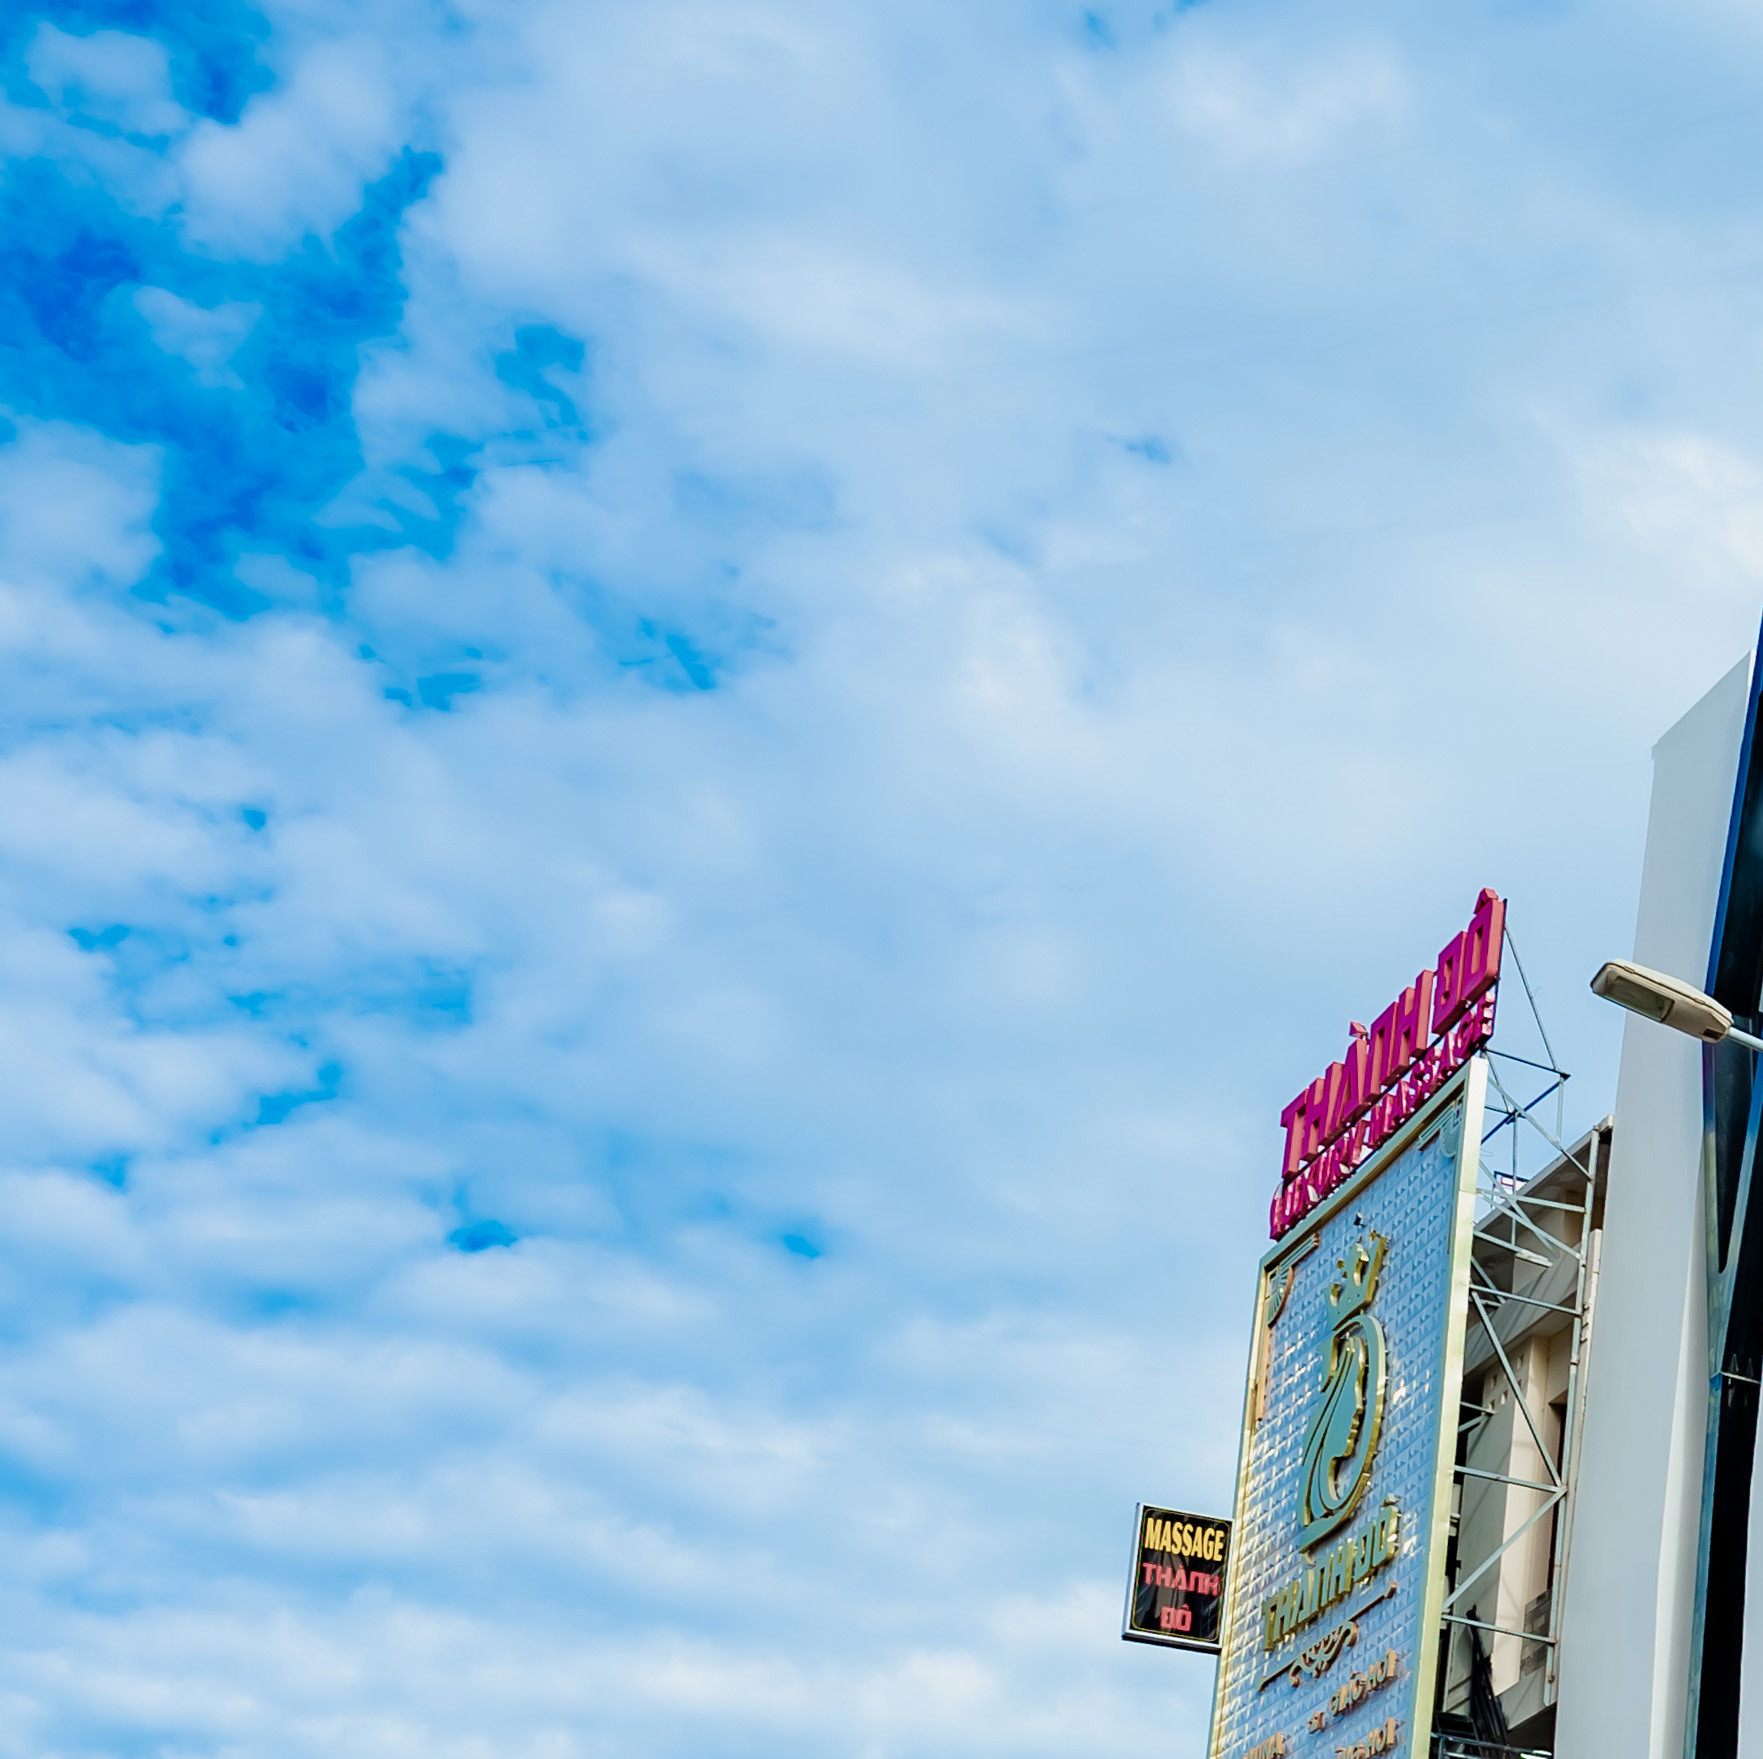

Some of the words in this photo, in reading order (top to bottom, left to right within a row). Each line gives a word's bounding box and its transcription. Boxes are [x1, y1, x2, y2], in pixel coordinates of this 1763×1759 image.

[1280, 969, 1435, 1180] THÀNH
[1431, 887, 1505, 1034] ĐÔ
[1369, 988, 1495, 1150] MASSAGE
[1144, 1517, 1225, 1562] MASSAGE
[1142, 1562, 1220, 1597] THÀNH
[1159, 1604, 1192, 1632] ĐÔ
[1262, 1538, 1355, 1651] THÀNH
